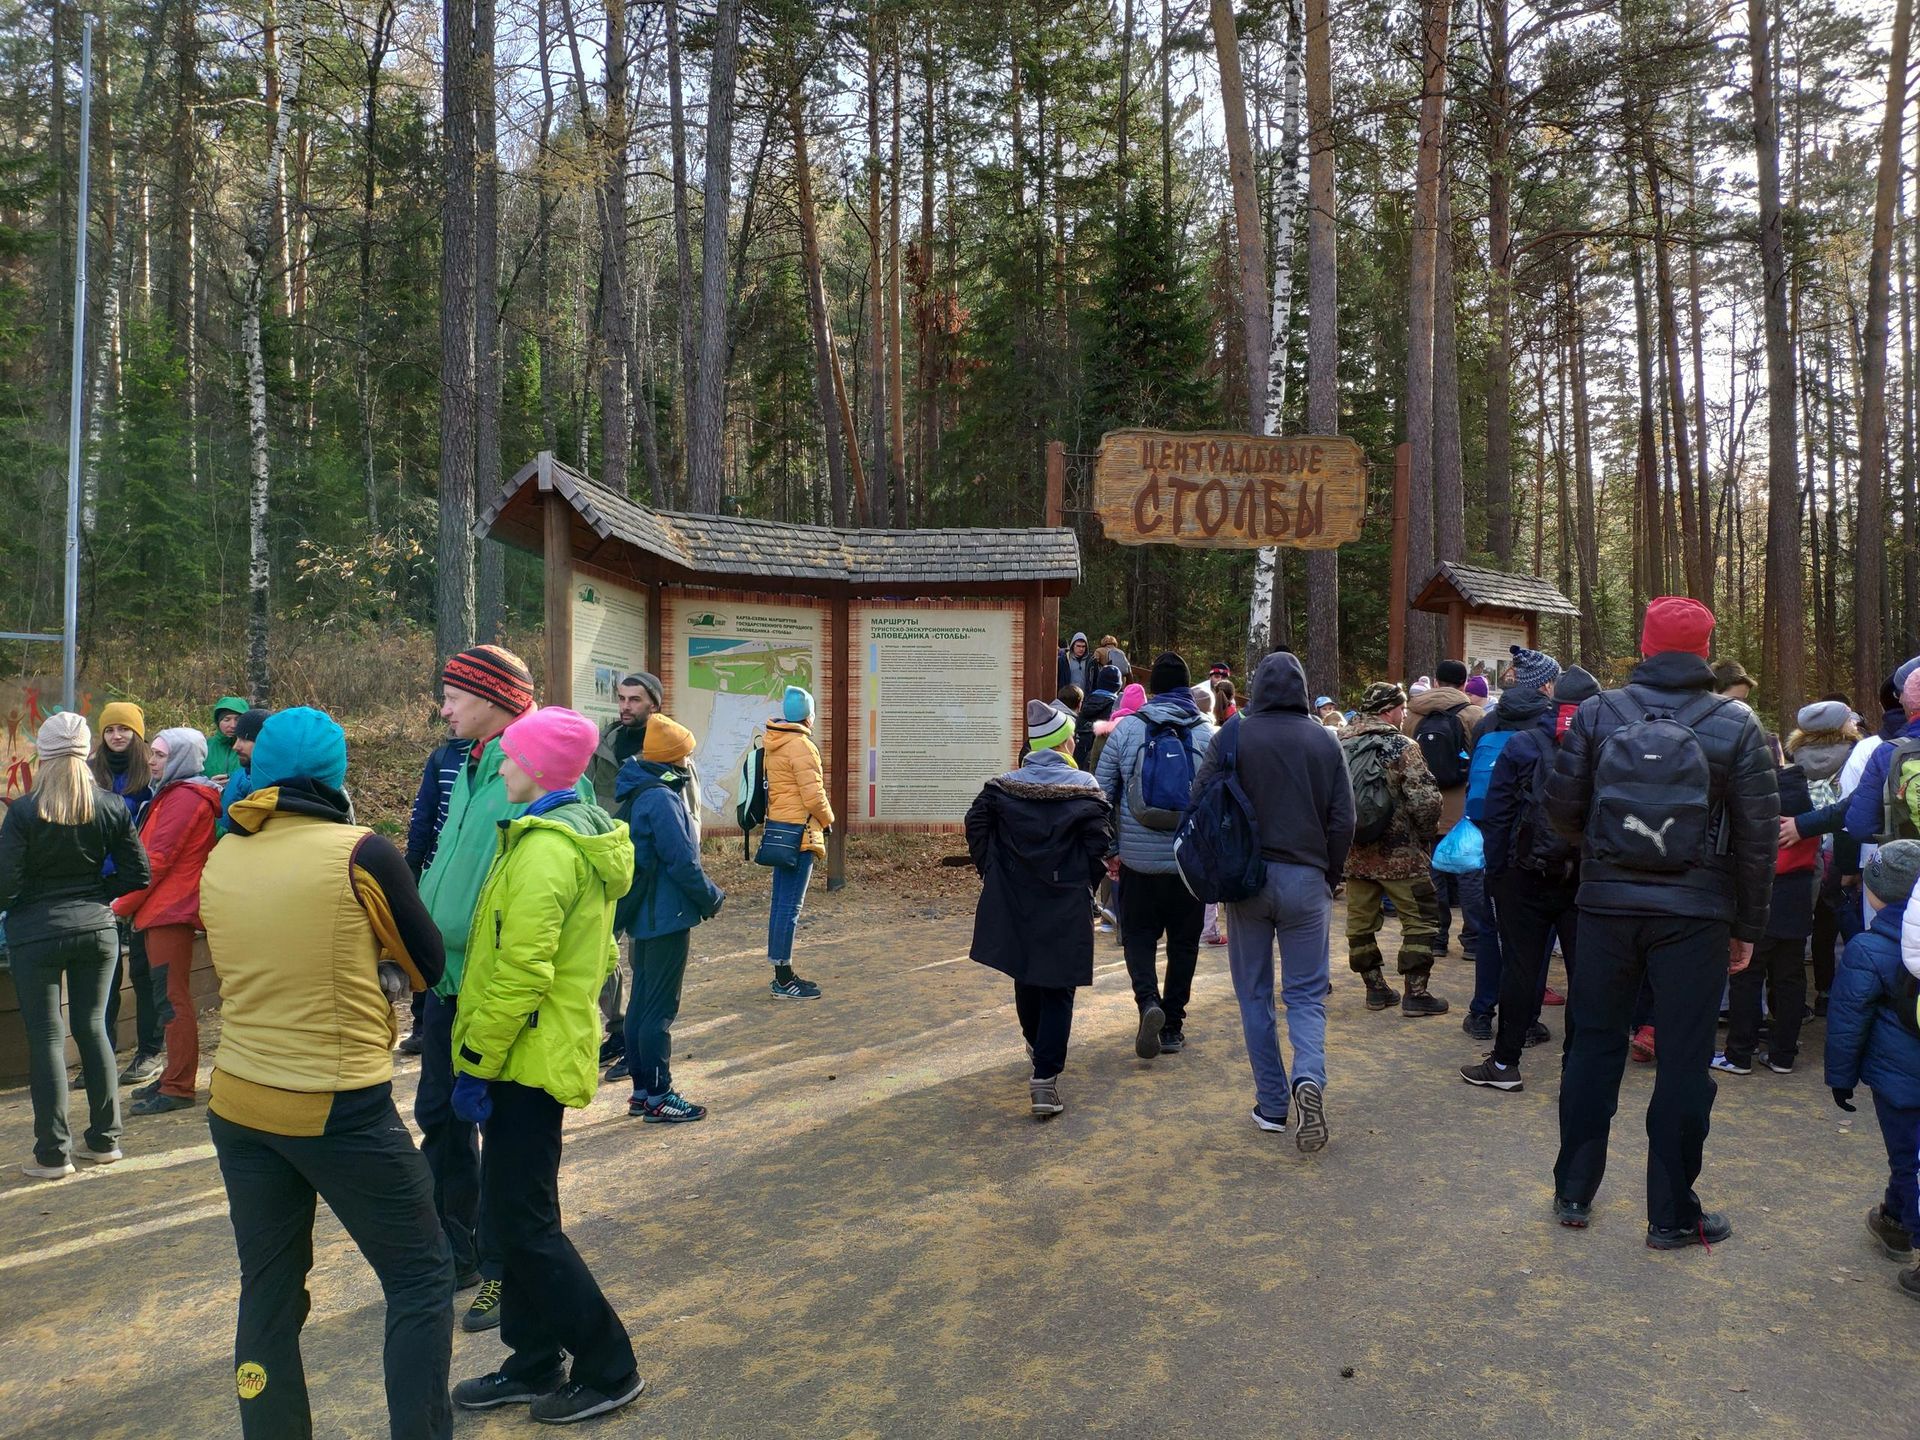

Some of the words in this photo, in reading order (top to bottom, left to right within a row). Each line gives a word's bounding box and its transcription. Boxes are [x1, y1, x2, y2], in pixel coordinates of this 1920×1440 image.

[1142, 439, 1325, 475] ЦЕНТРАЛЬНЫЕ
[1134, 473, 1324, 539] СТОЛБЫ
[871, 632, 930, 640] ЗАПОВЕДНИКА
